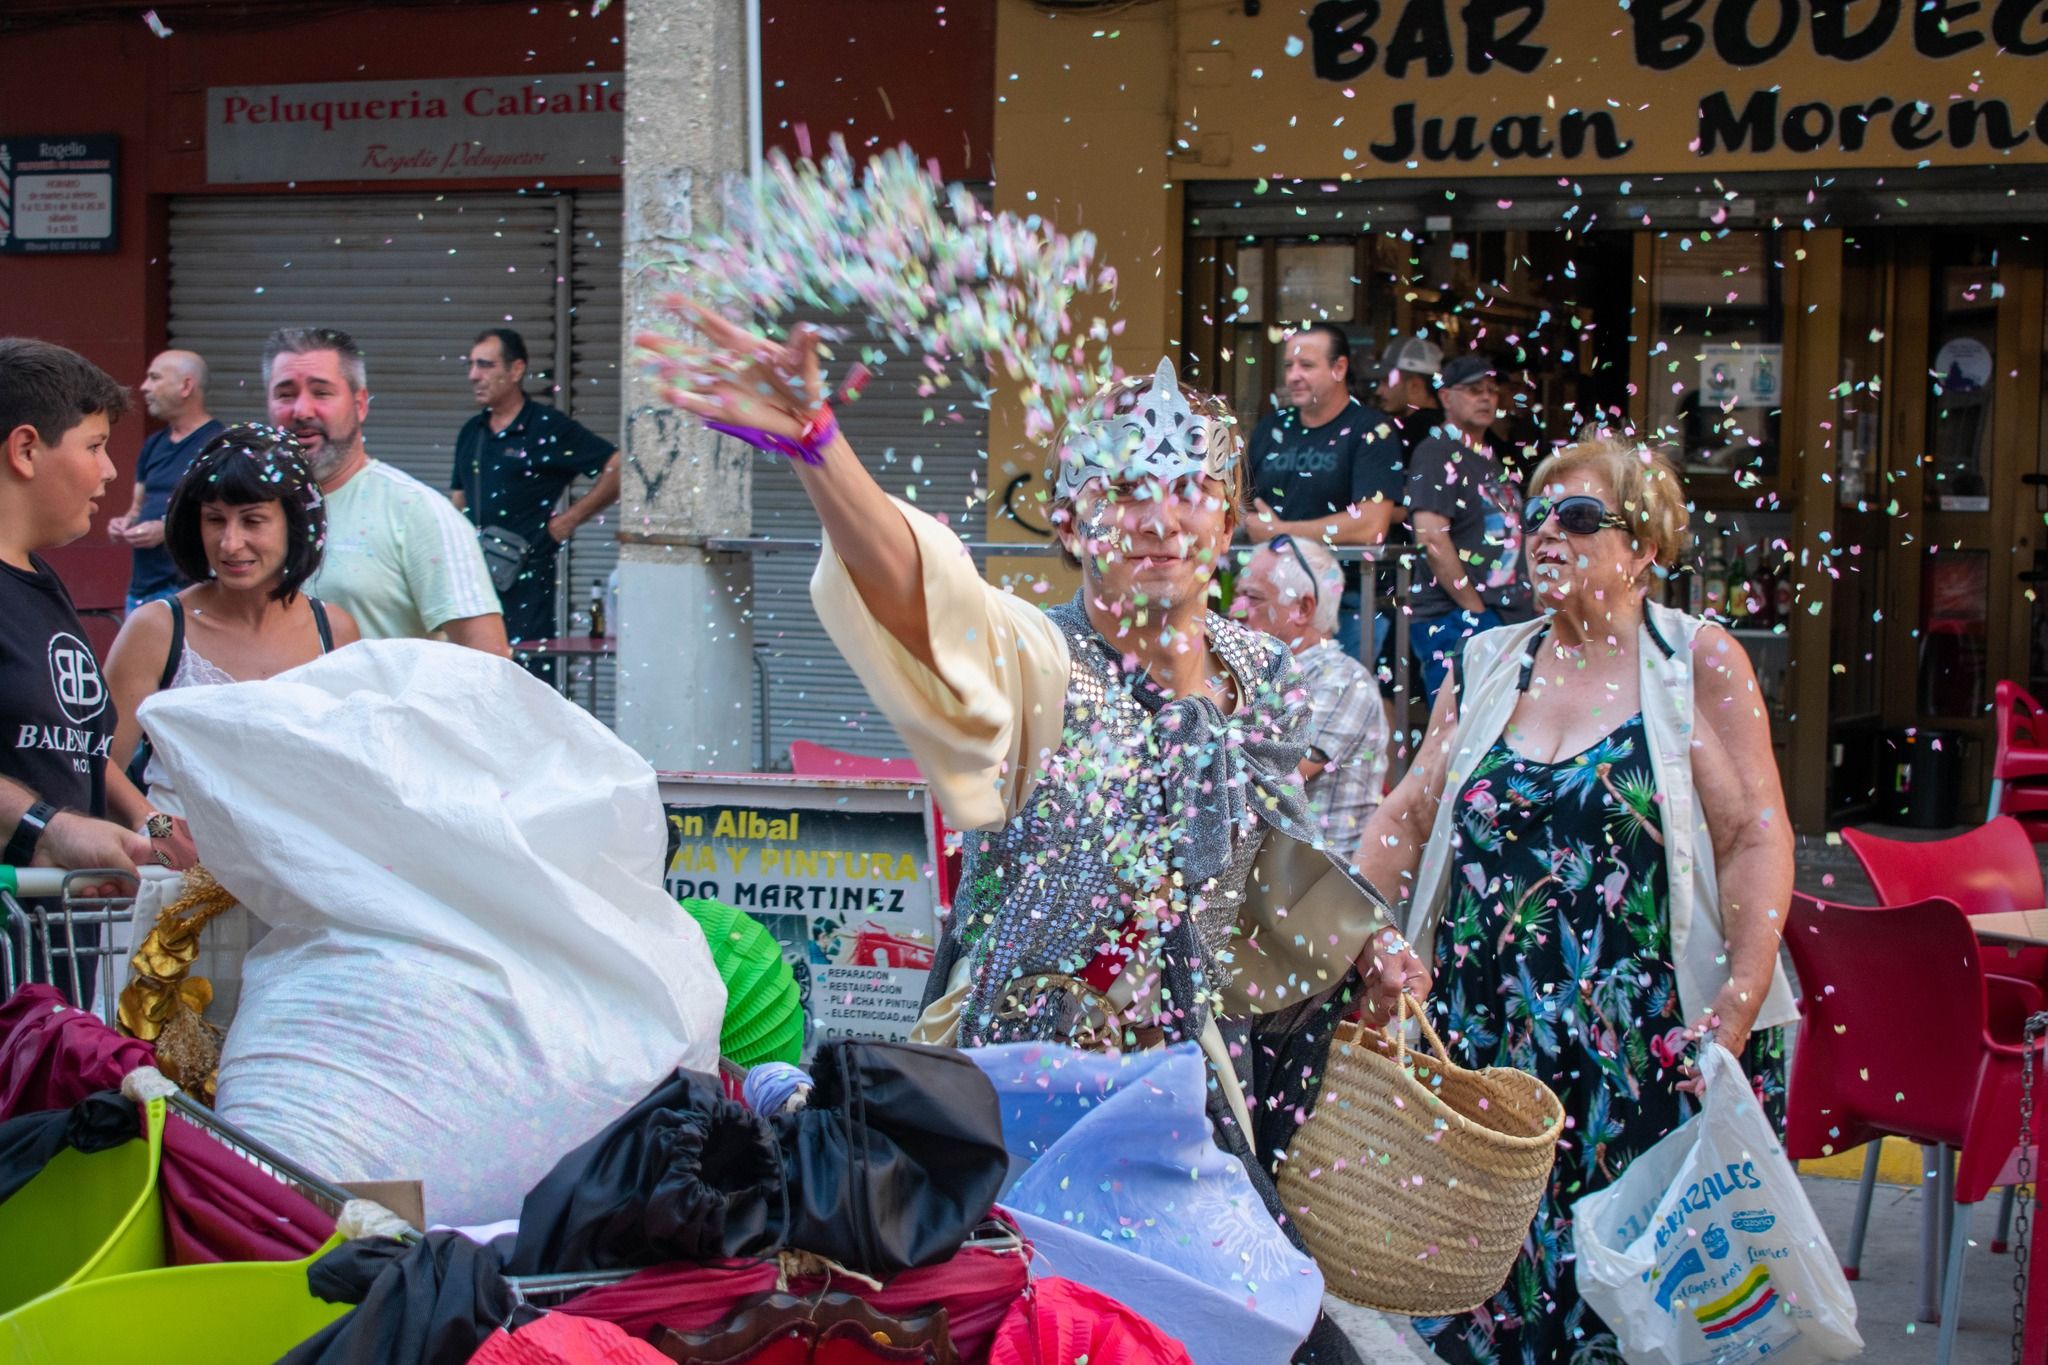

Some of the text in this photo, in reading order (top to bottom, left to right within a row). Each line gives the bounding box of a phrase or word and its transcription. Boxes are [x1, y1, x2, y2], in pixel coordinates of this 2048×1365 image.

[1309, 0, 1549, 81] BAR
[222, 91, 448, 131] Peluqueria
[1370, 103, 1635, 164] Juan
[39, 142, 87, 159] Rogelio
[361, 143, 437, 173] Rogelio
[712, 810, 799, 841] Albal
[727, 847, 750, 874] Y
[760, 849, 918, 882] PINTURA
[735, 882, 906, 914] MARTINEZ
[885, 998, 920, 1010] PINTUR
